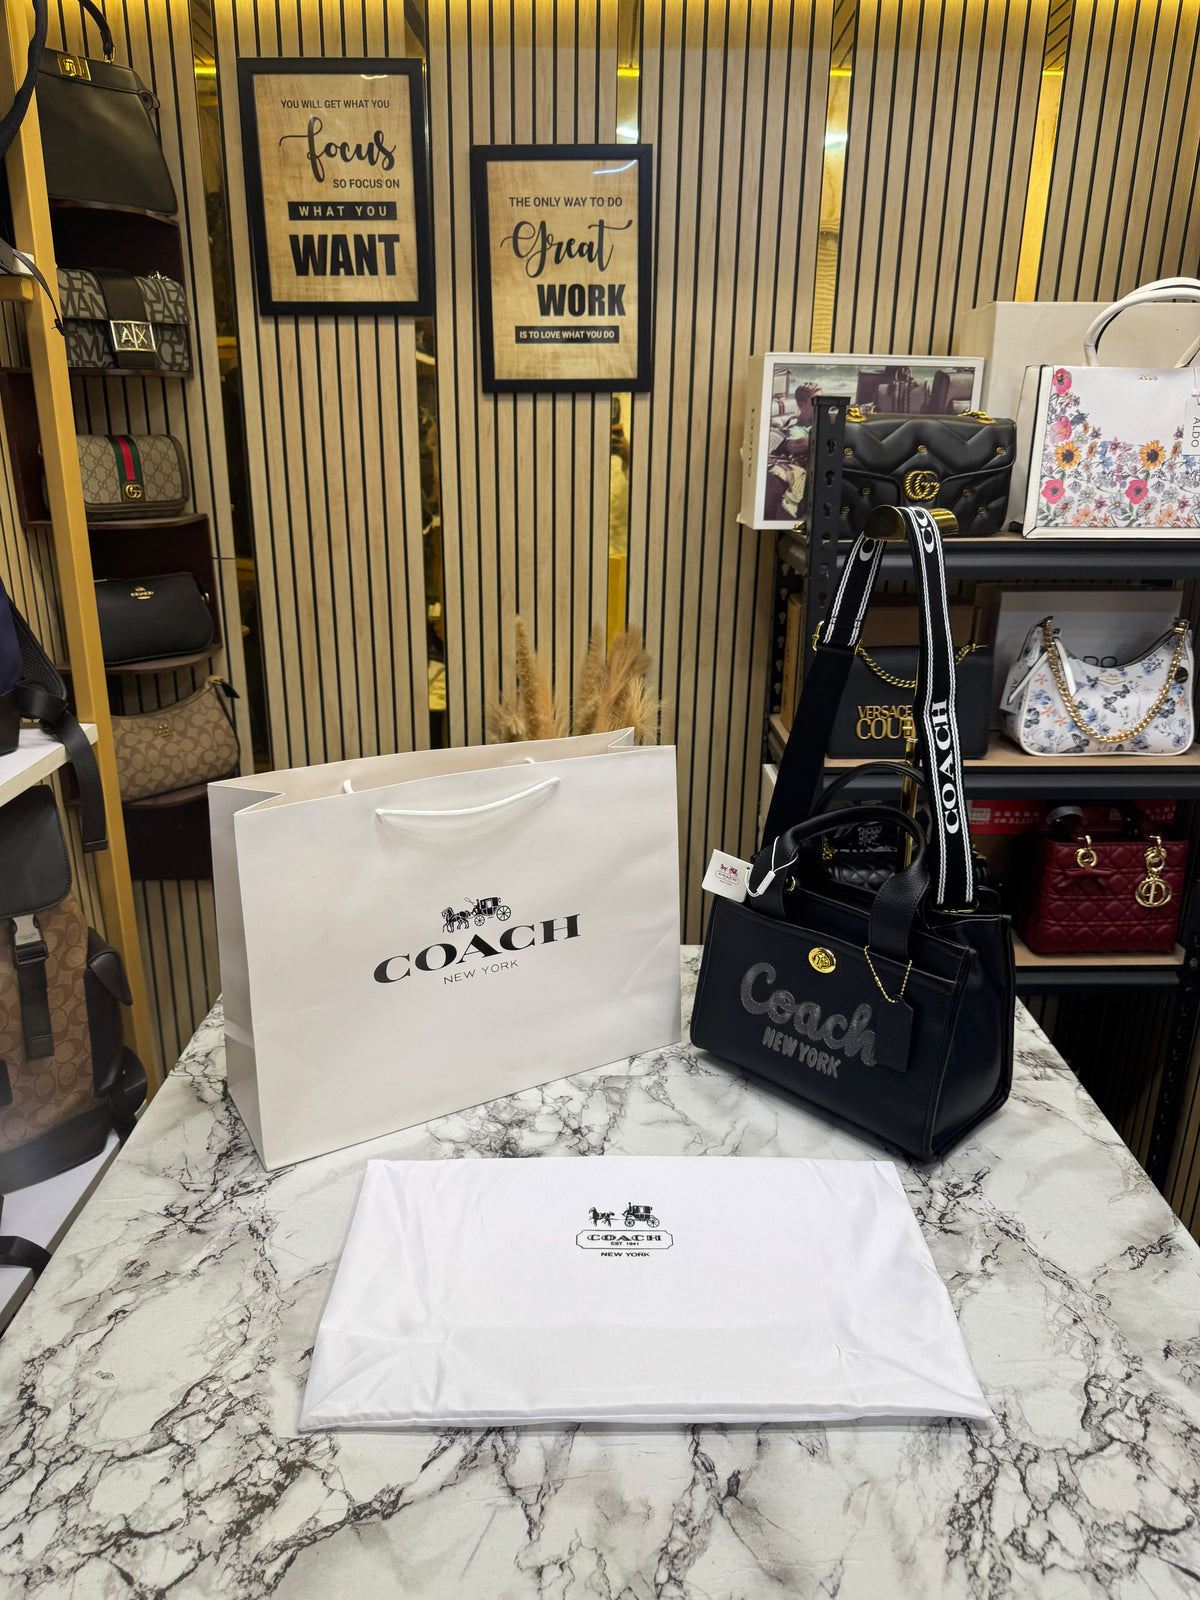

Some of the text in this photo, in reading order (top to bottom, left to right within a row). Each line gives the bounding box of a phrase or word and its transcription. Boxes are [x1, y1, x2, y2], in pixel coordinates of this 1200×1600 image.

[280, 99, 390, 109] YOU WILL GET WHAT YOU
[279, 116, 396, 183] focus
[332, 178, 400, 189] SO FOCUS ON
[298, 205, 388, 217] WHAT YOU
[508, 196, 623, 207] THE ONLY WAY TO DO
[288, 233, 400, 277] WANT
[500, 219, 633, 278] Great
[536, 283, 627, 317] WORK
[519, 330, 615, 339] IS TO LOVE WHAT YOU DO
[857, 704, 913, 719] VERSACE
[931, 699, 960, 834] COACH
[372, 913, 582, 984] COACH
[443, 959, 520, 985] NEW YORK
[740, 962, 878, 1067] Coach
[761, 1026, 842, 1079] NEW YORK
